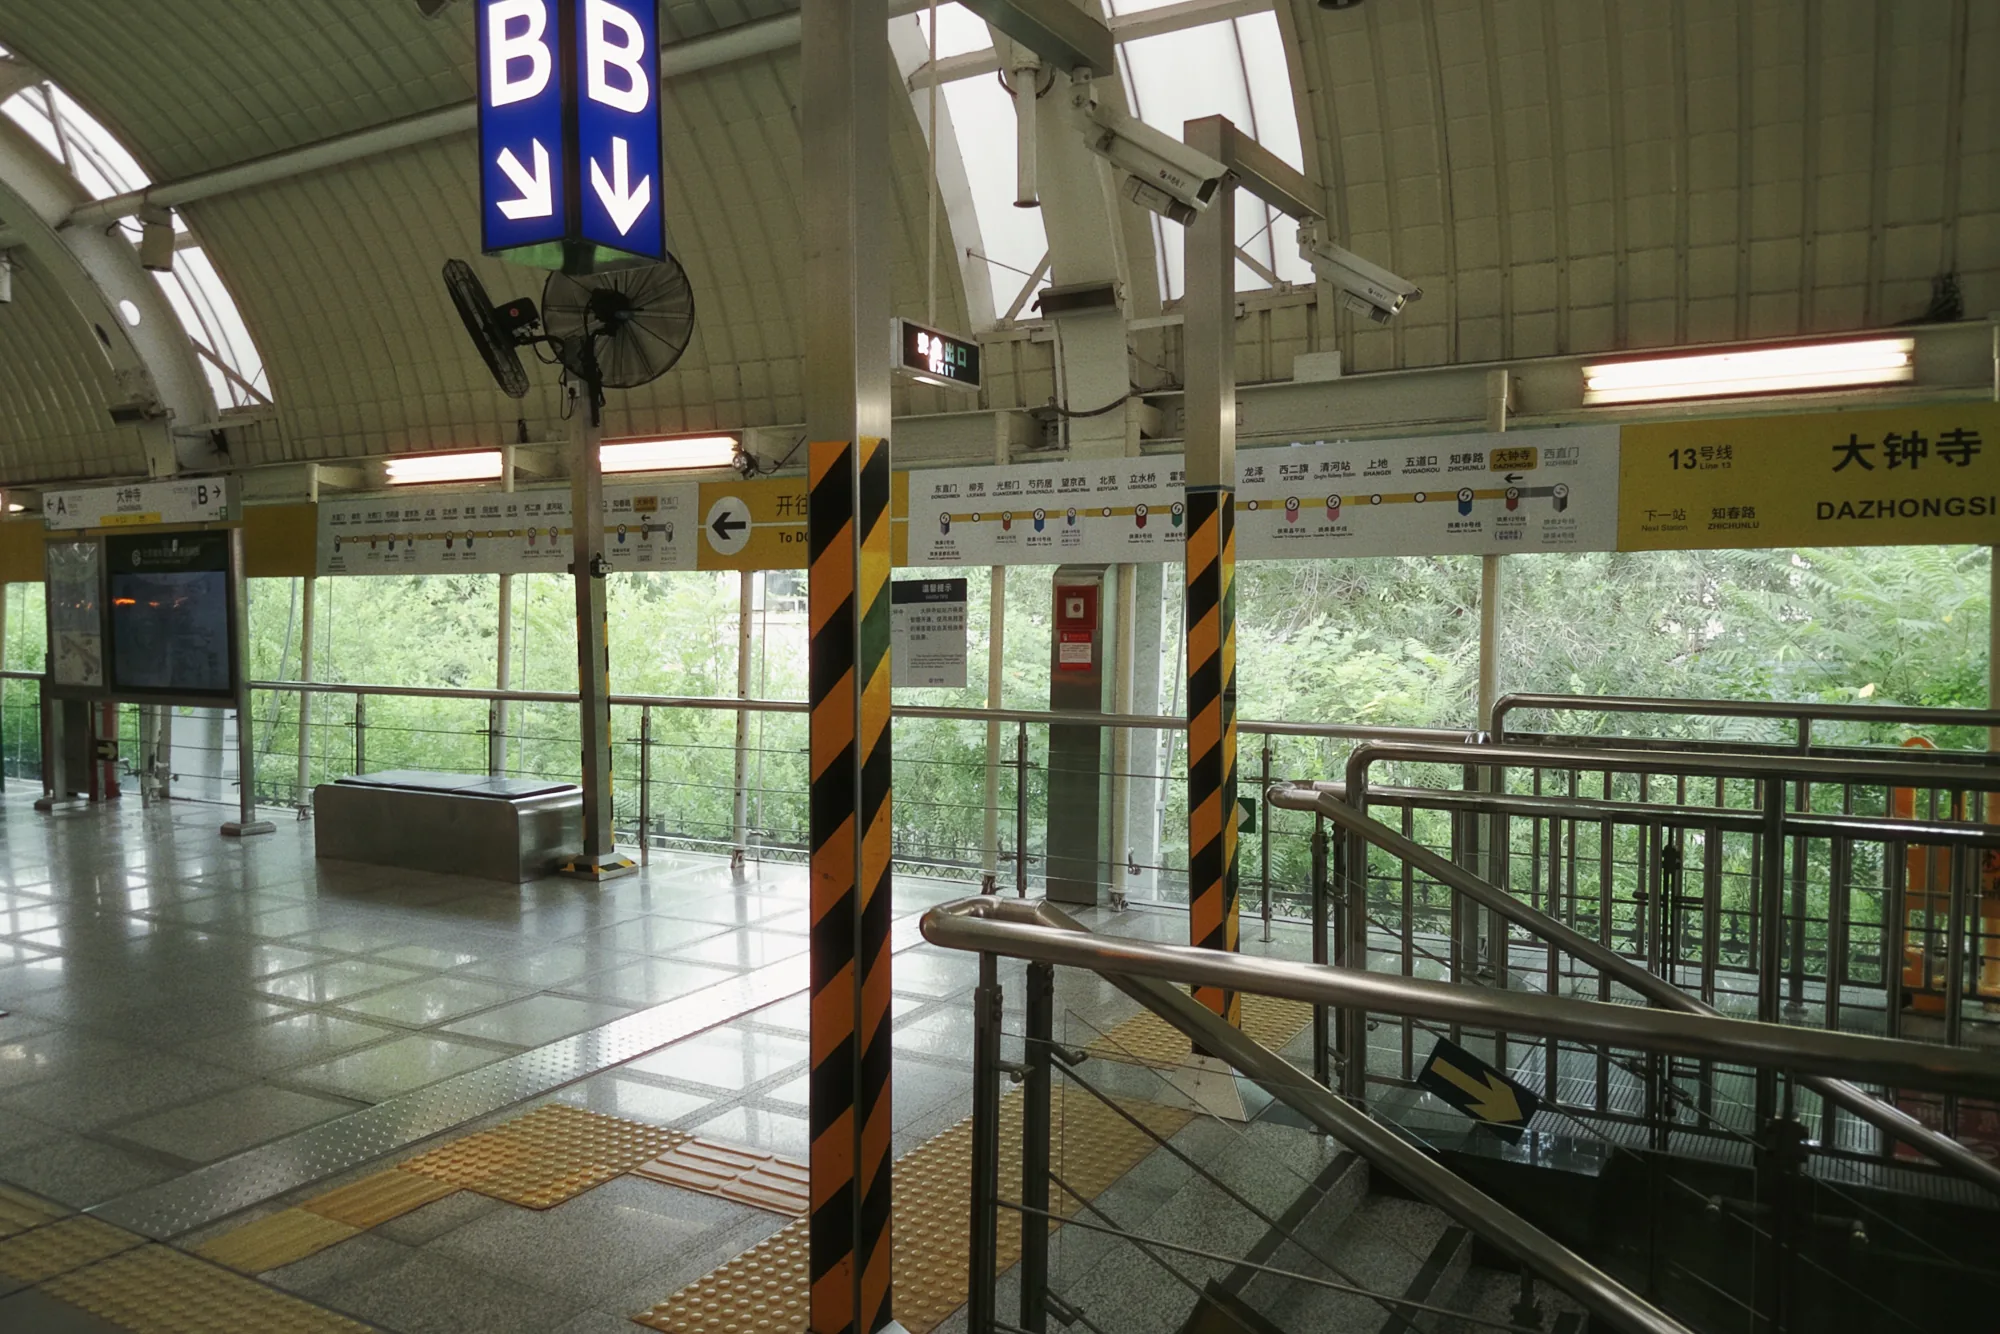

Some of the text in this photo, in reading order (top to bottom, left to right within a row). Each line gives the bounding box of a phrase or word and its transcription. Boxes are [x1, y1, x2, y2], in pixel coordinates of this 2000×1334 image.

[488, 0, 551, 107] B
[586, 0, 649, 113] B
[1544, 447, 1579, 459] 西直门
[1831, 428, 1983, 472] 大钟寺
[1405, 456, 1437, 467] 五道口
[1450, 453, 1484, 464] 知春路
[1496, 450, 1530, 462] 大钟寺
[1320, 461, 1351, 472] 清河站
[1367, 458, 1388, 470] 上地
[1447, 464, 1485, 472] ZHICHUNLU
[1545, 459, 1578, 467] XIZHIMEN
[1244, 466, 1264, 477] 龙泽
[1279, 464, 1309, 475] 西二旗
[1363, 469, 1391, 477] SHANGDI
[1061, 477, 1086, 487] 望京西
[1099, 475, 1116, 485] 北苑
[1129, 473, 1156, 483] 立水桥
[935, 484, 957, 493] 东直门
[969, 483, 984, 492] 柳芳
[996, 480, 1020, 490] 光熙门
[1028, 479, 1053, 489] 芍药居
[197, 485, 208, 505] B
[57, 496, 67, 515] A
[776, 494, 808, 516] 开往
[1816, 495, 1997, 520] DAZHONGSI
[1644, 508, 1686, 521] 下一站
[1712, 506, 1756, 520] 知春路
[1661, 524, 1688, 532] Station
[1708, 521, 1760, 530] ZHICHUNLU
[779, 532, 792, 543] To
